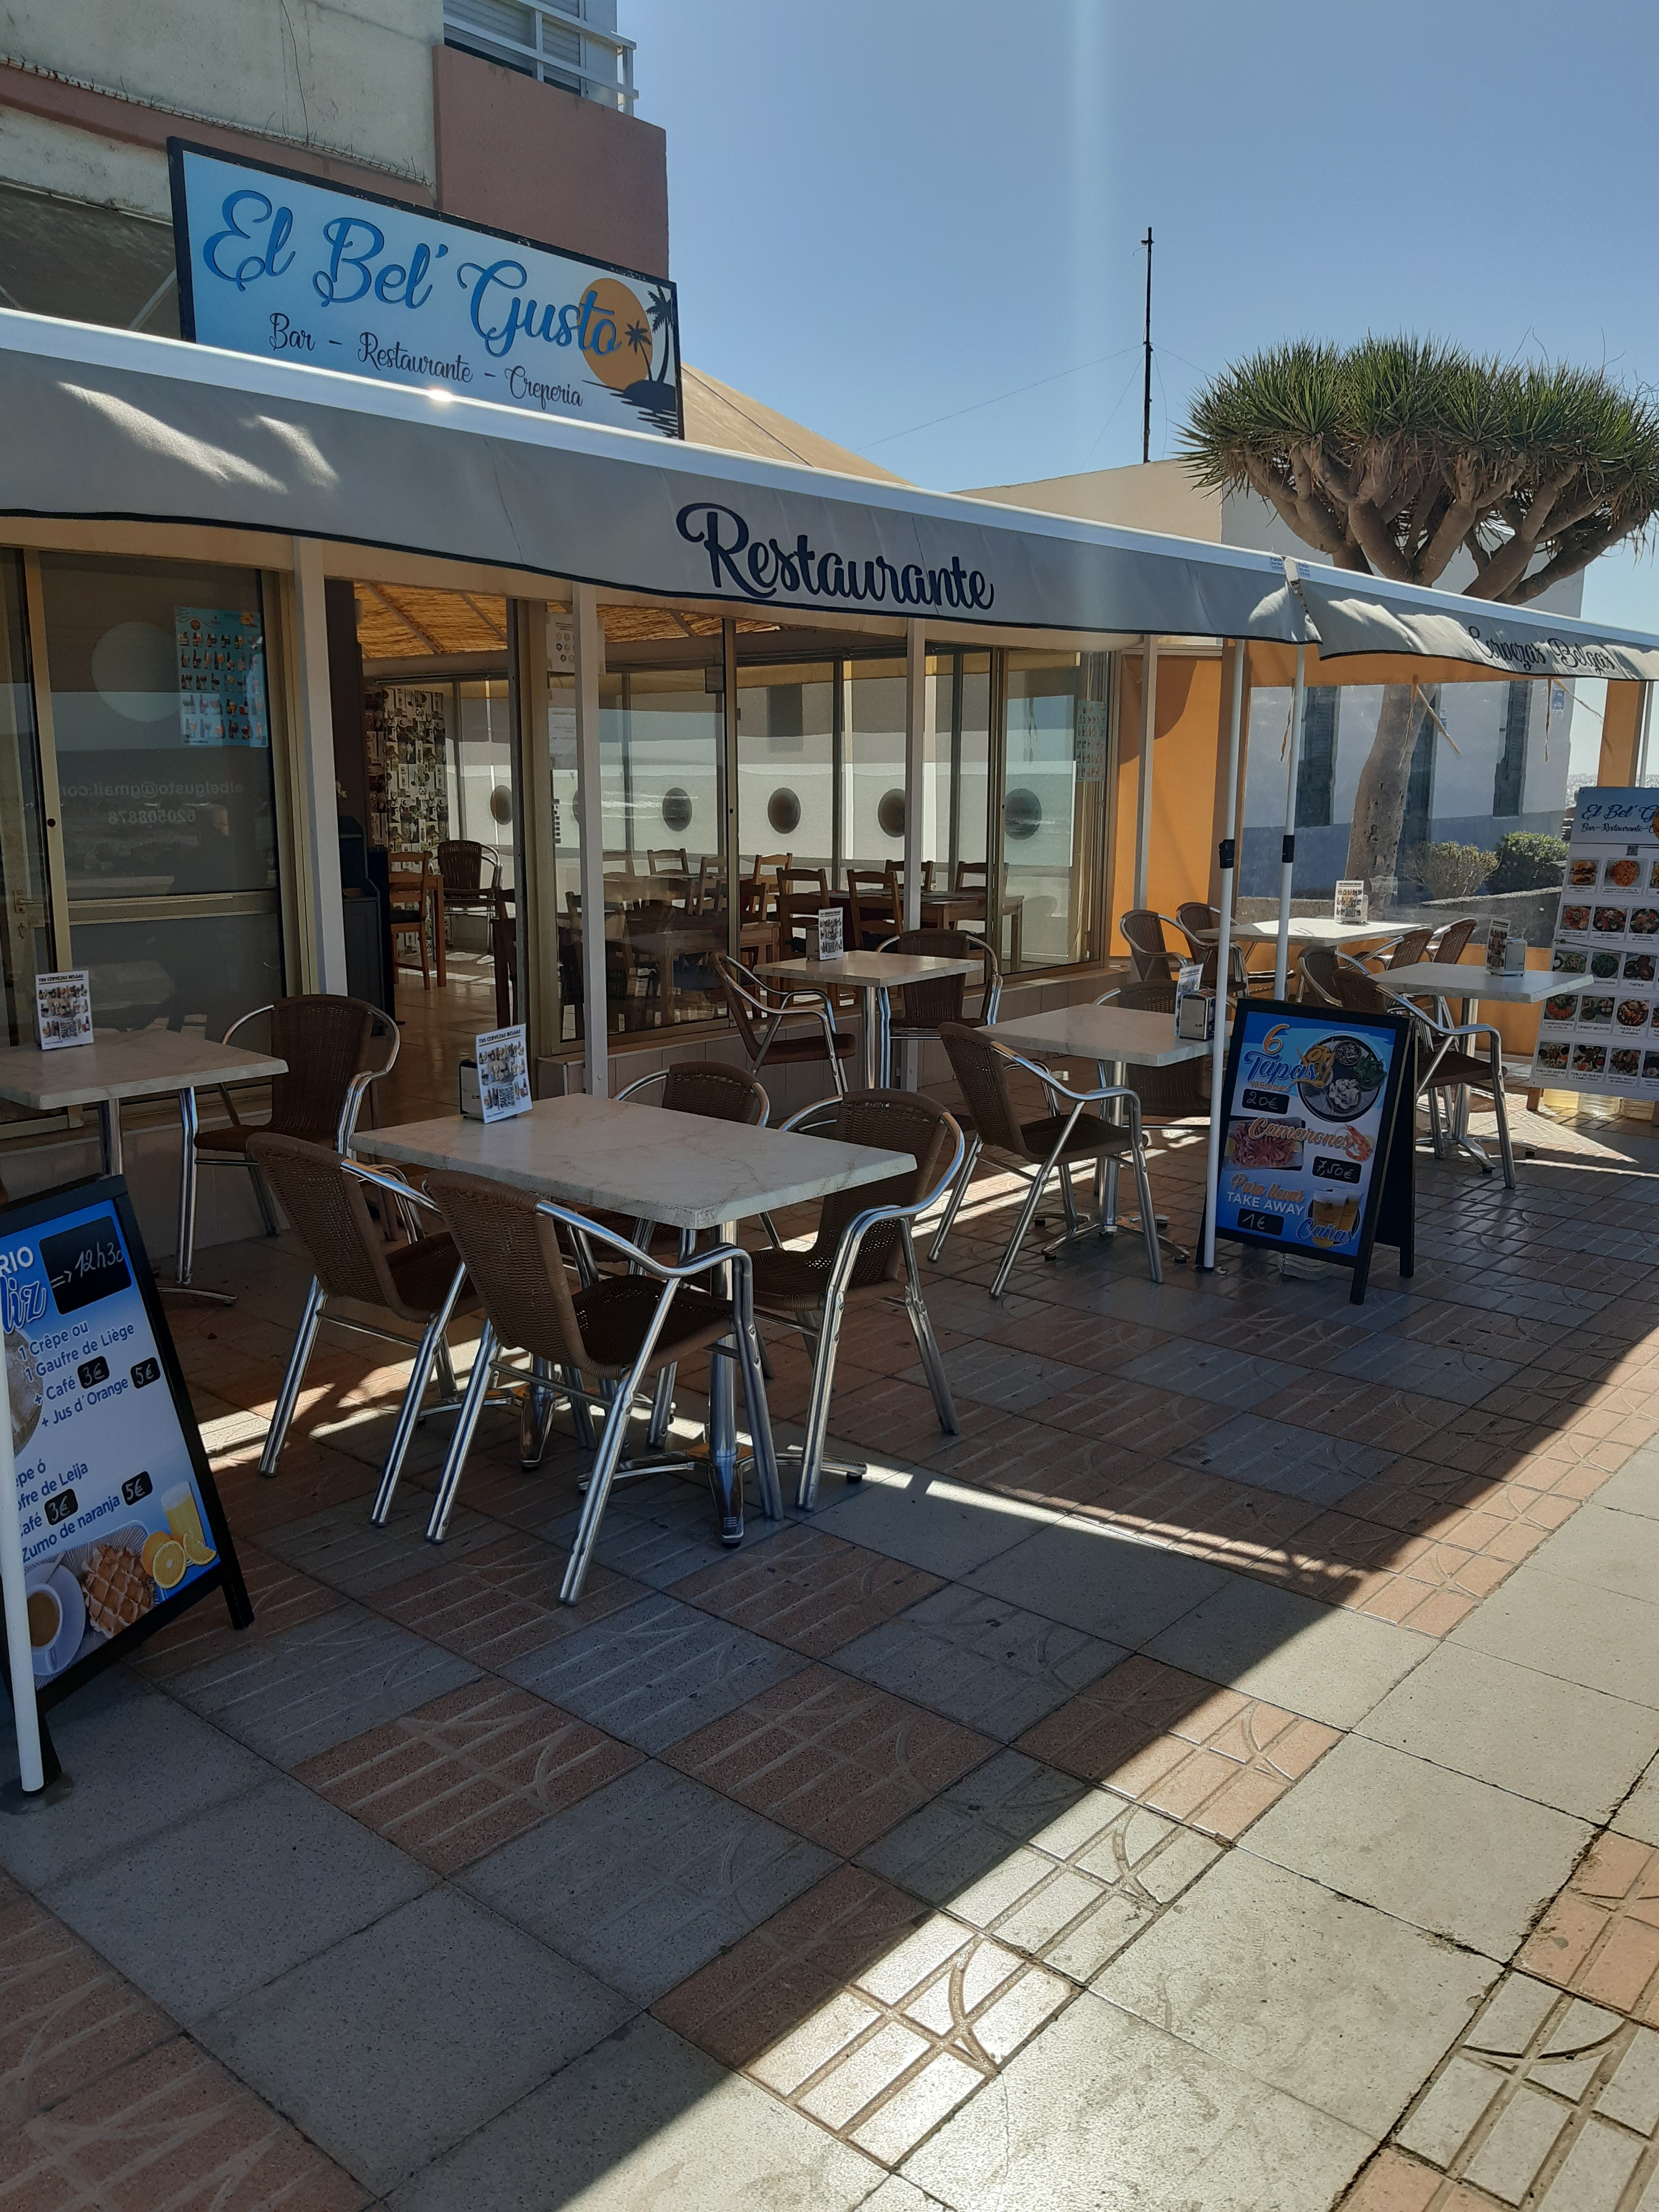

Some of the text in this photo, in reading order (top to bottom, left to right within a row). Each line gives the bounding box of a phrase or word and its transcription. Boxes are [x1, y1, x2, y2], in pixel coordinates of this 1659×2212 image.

[203, 190, 295, 291] El
[457, 260, 621, 356] Gusto
[270, 312, 315, 350] Bar
[358, 331, 473, 383] Restaurante
[504, 365, 583, 409] Creperia
[676, 503, 994, 610] Restaurante
[1468, 626, 1615, 676] Cervezas Belgas
[1582, 804, 1602, 820] El
[487, 1033, 506, 1042] CERVEZAS
[1262, 1023, 1290, 1055] 6
[1243, 1050, 1319, 1083] Tapas
[1246, 1092, 1278, 1109] 20€
[1249, 1080, 1289, 1092] VARIADAS
[1249, 1117, 1356, 1150] Camarones
[1227, 1192, 1304, 1216] TAKE AWAY
[1230, 1173, 1305, 1203] Para llevar
[1243, 1211, 1266, 1231] 1€
[1297, 1217, 1355, 1244] Cañas
[75, 1242, 123, 1277] 12h30
[30, 1330, 69, 1355] Crêpe
[72, 1322, 88, 1336] ou
[36, 1346, 80, 1377] Gaufre
[82, 1336, 99, 1356] de
[102, 1322, 135, 1348] Liège
[47, 1375, 77, 1401] Café
[53, 1406, 72, 1425] Jus
[41, 1480, 57, 1496] de
[59, 1463, 88, 1486] Leija
[20, 1512, 42, 1537] afé
[22, 1534, 57, 1563] Zumo
[60, 1523, 75, 1539] de
[78, 1495, 120, 1527] naranja
